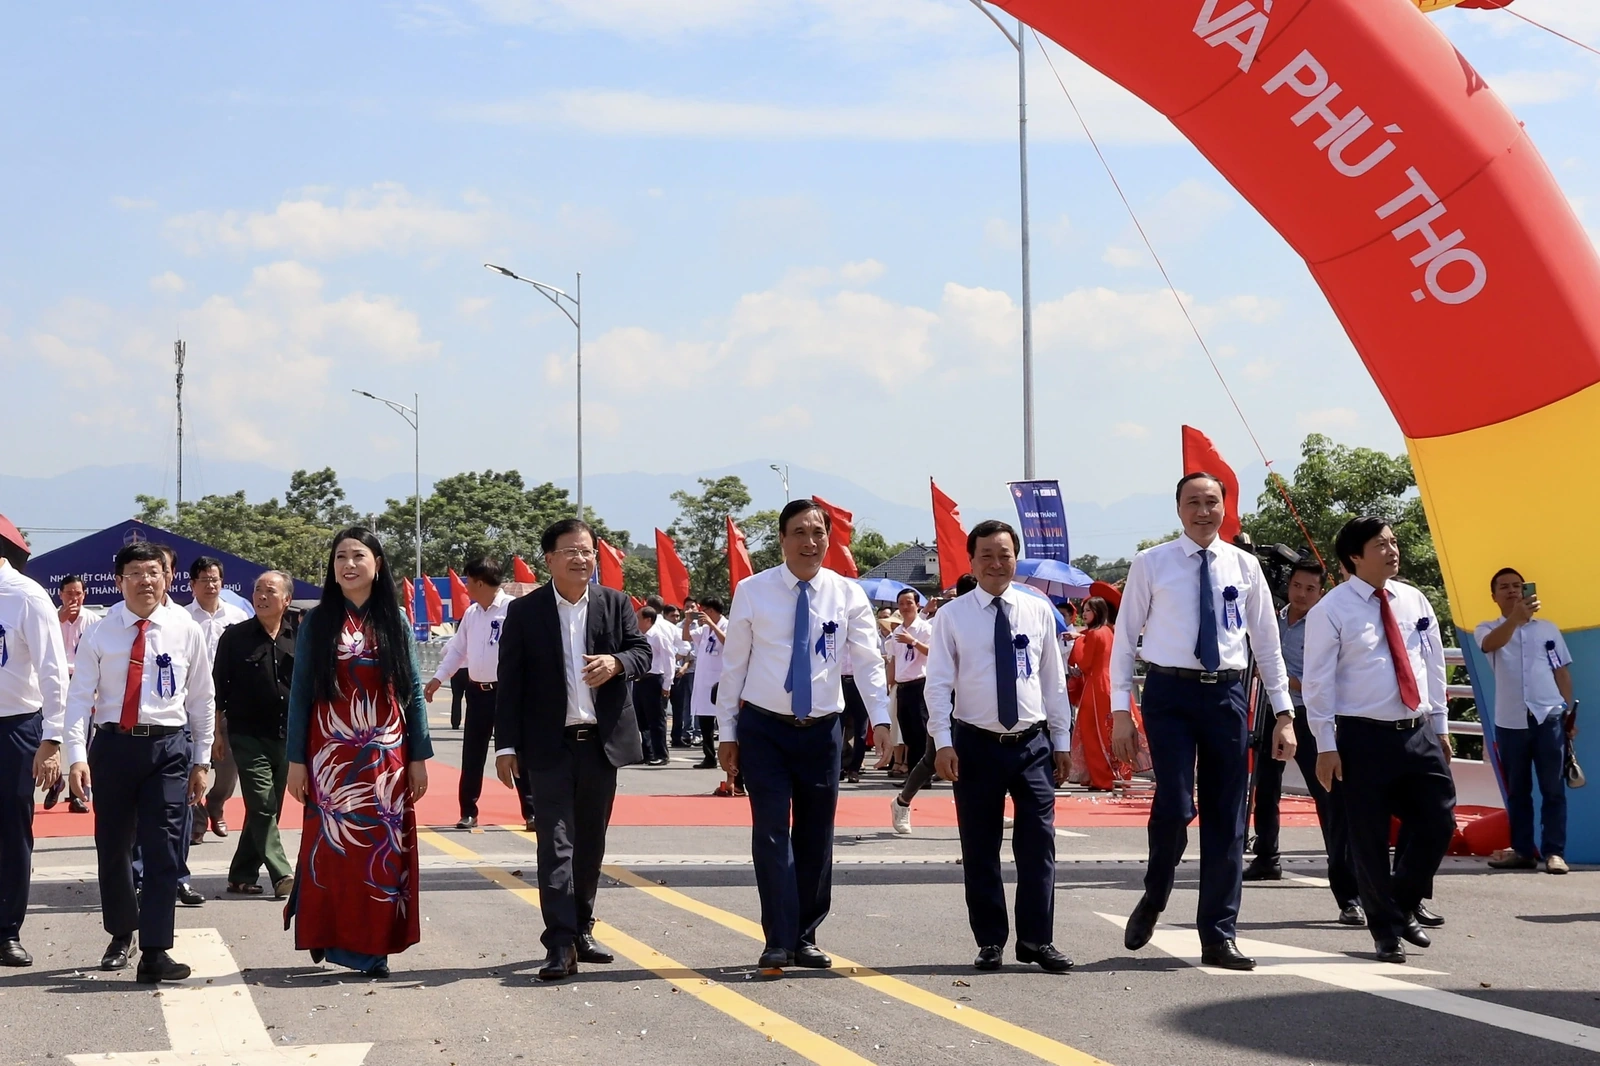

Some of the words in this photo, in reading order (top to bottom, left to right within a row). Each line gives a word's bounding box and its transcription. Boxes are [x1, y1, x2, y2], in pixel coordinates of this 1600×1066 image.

[1192, 0, 1274, 74] VÀ
[1261, 48, 1404, 178] PHÚ
[1374, 165, 1488, 305] THỌ
